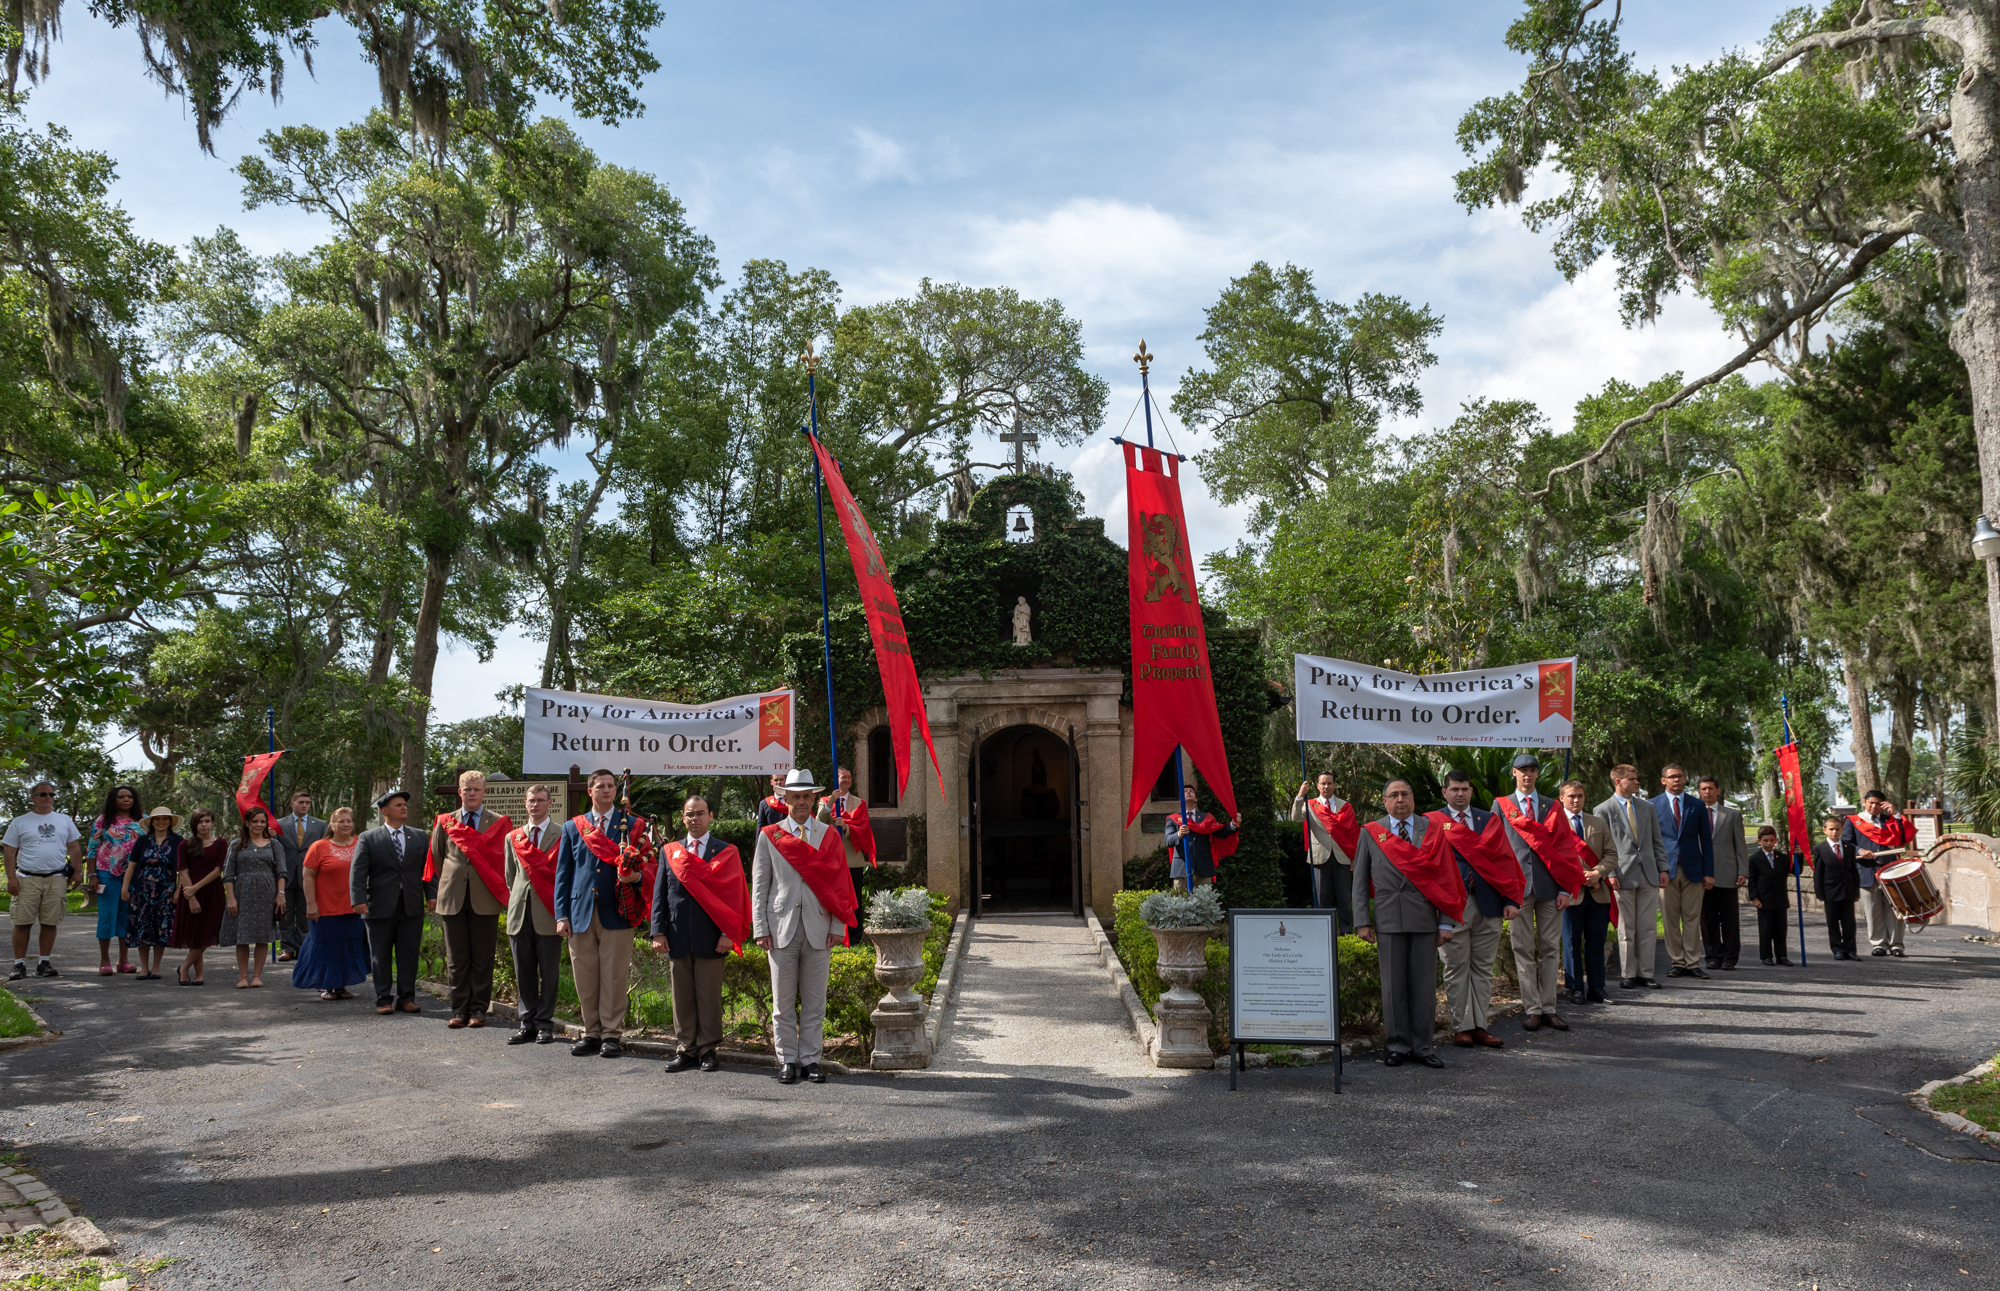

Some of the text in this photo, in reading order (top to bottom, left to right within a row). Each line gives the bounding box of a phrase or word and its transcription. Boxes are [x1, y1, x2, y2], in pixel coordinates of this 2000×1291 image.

[1150, 643, 1199, 661] Family
[1309, 666, 1534, 693] Pray for America's
[540, 698, 755, 723] Pray for America's
[1320, 700, 1520, 724] Return to Order.
[551, 732, 742, 753] Return to Order.
